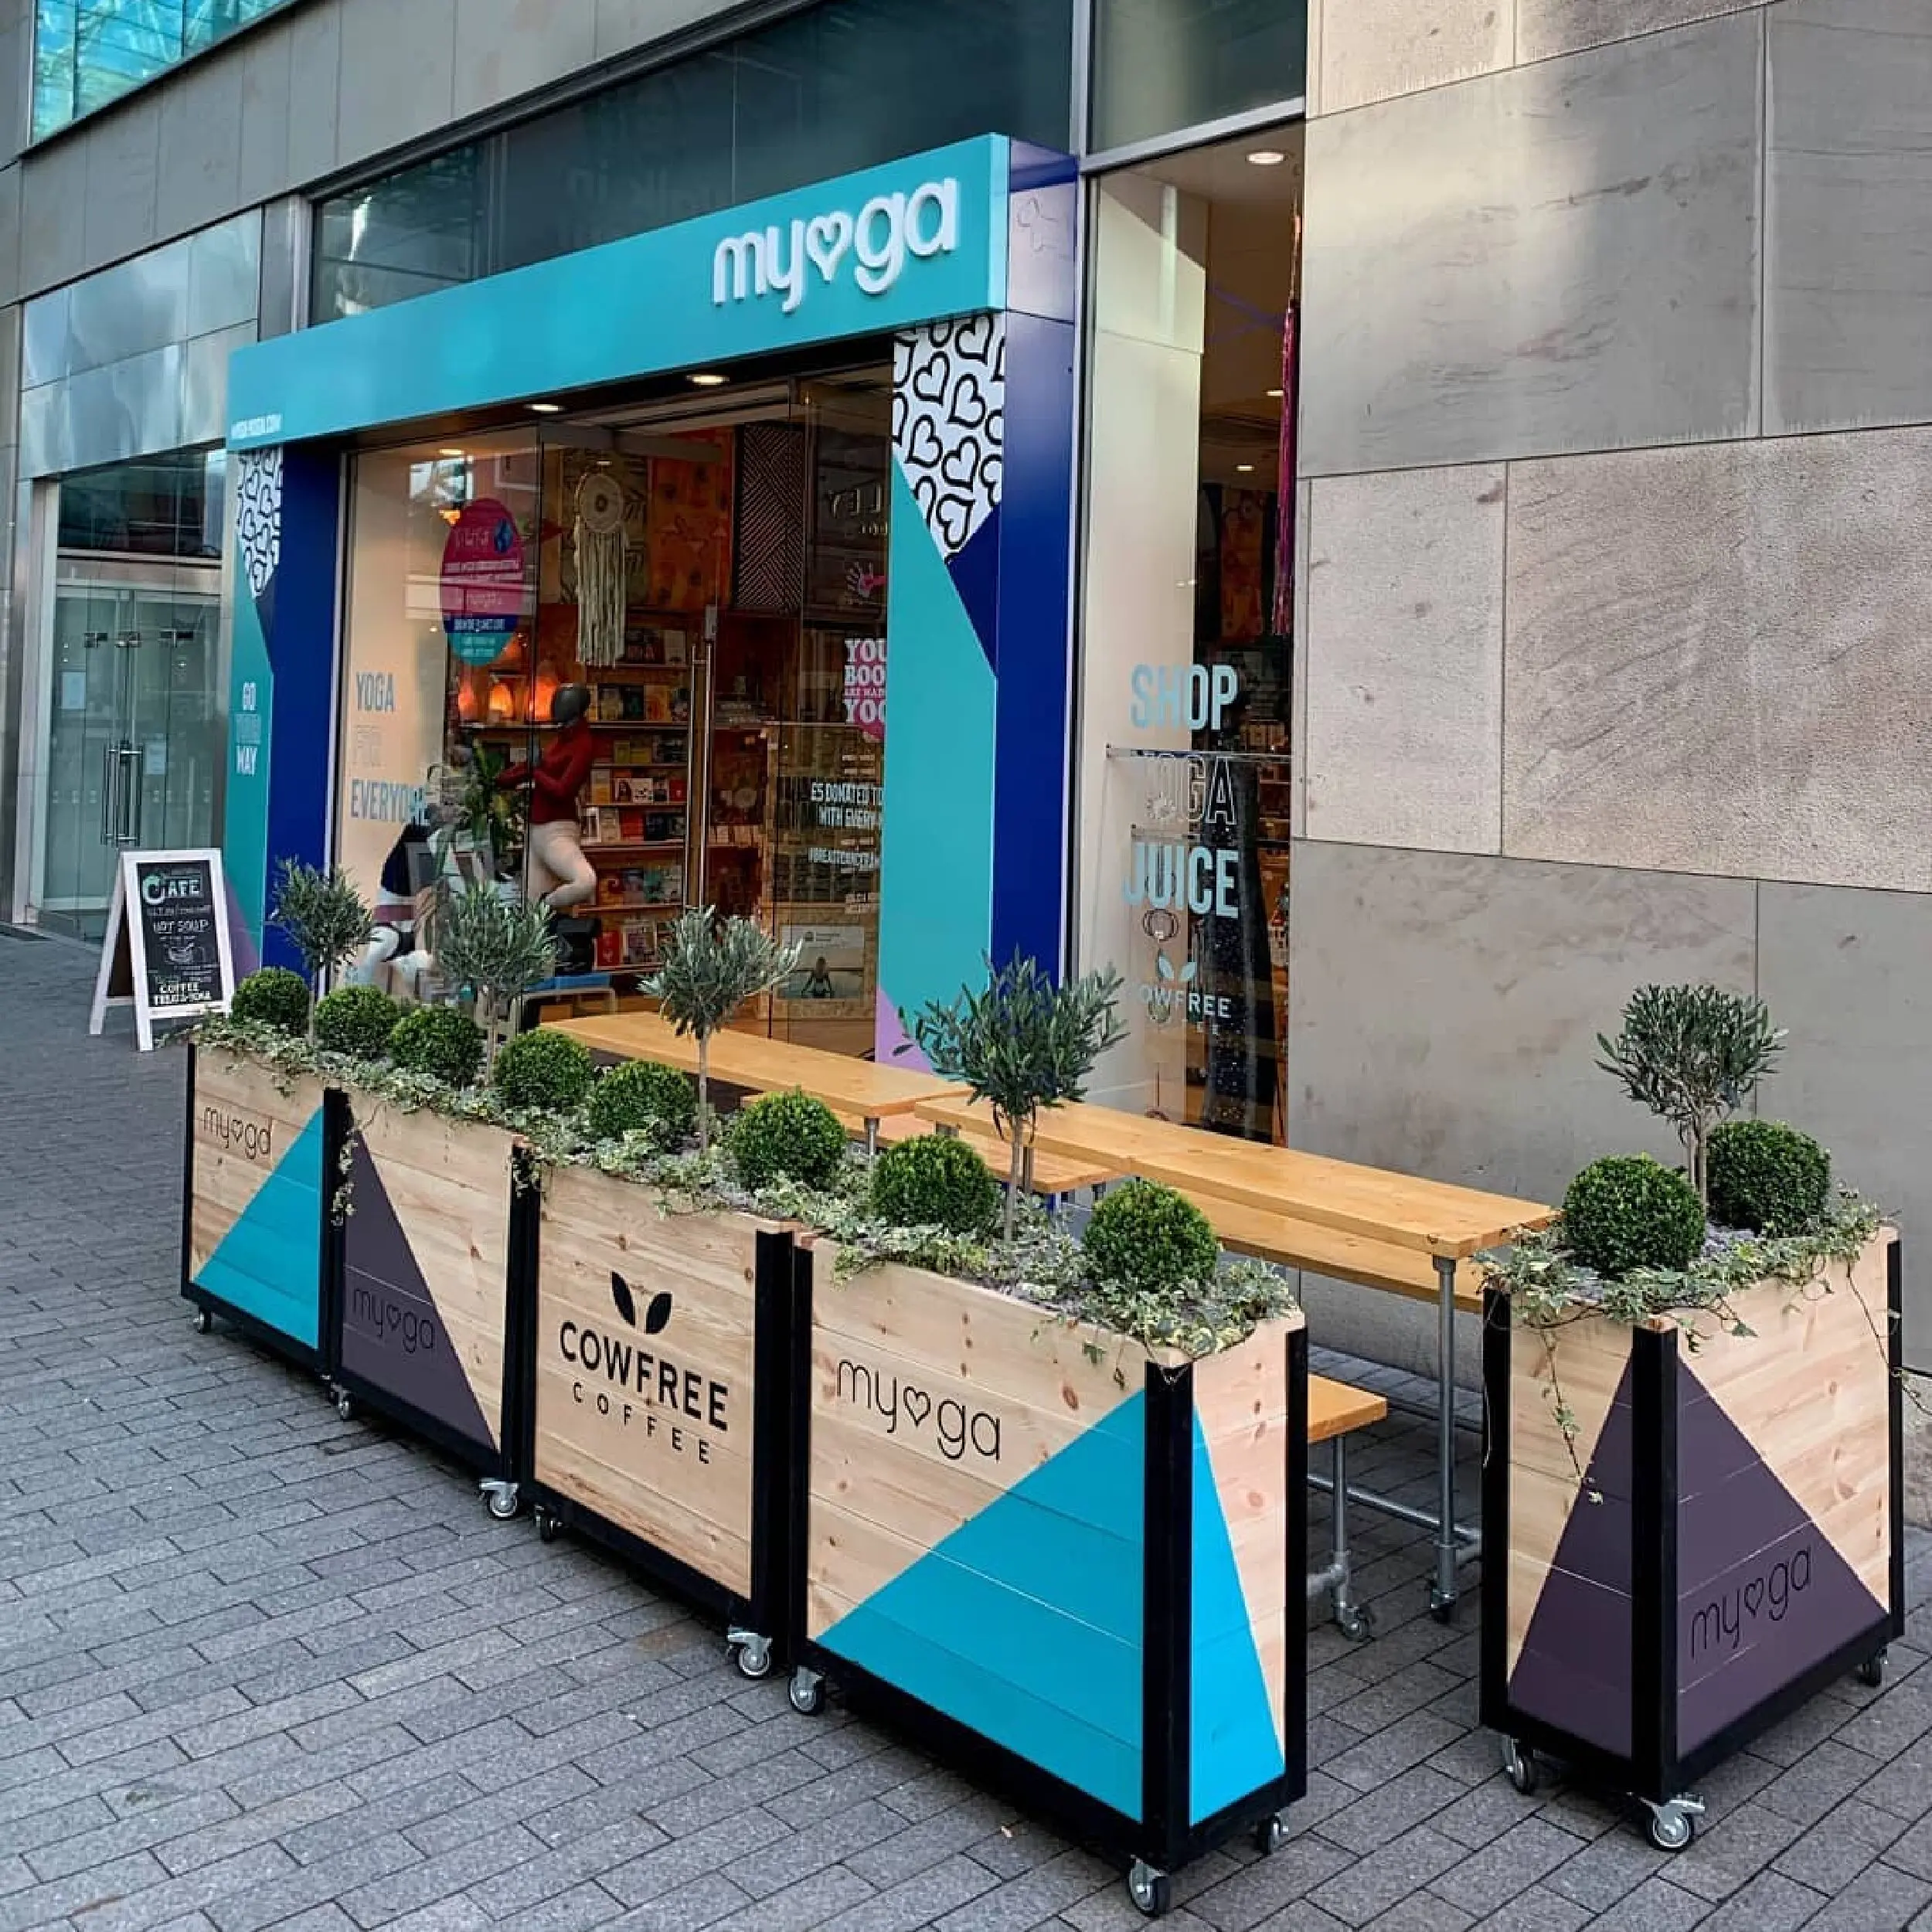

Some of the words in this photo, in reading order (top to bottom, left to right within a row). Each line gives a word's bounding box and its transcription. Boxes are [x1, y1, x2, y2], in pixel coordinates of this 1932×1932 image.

[356, 672, 396, 712] YOGA
[1131, 663, 1238, 730] SHOP
[142, 874, 200, 905] CAFE
[1123, 842, 1239, 919] JUICE
[1136, 983, 1233, 1019] OWFREE
[560, 1319, 729, 1432] COWFREE
[572, 1381, 710, 1464] COFFEE
